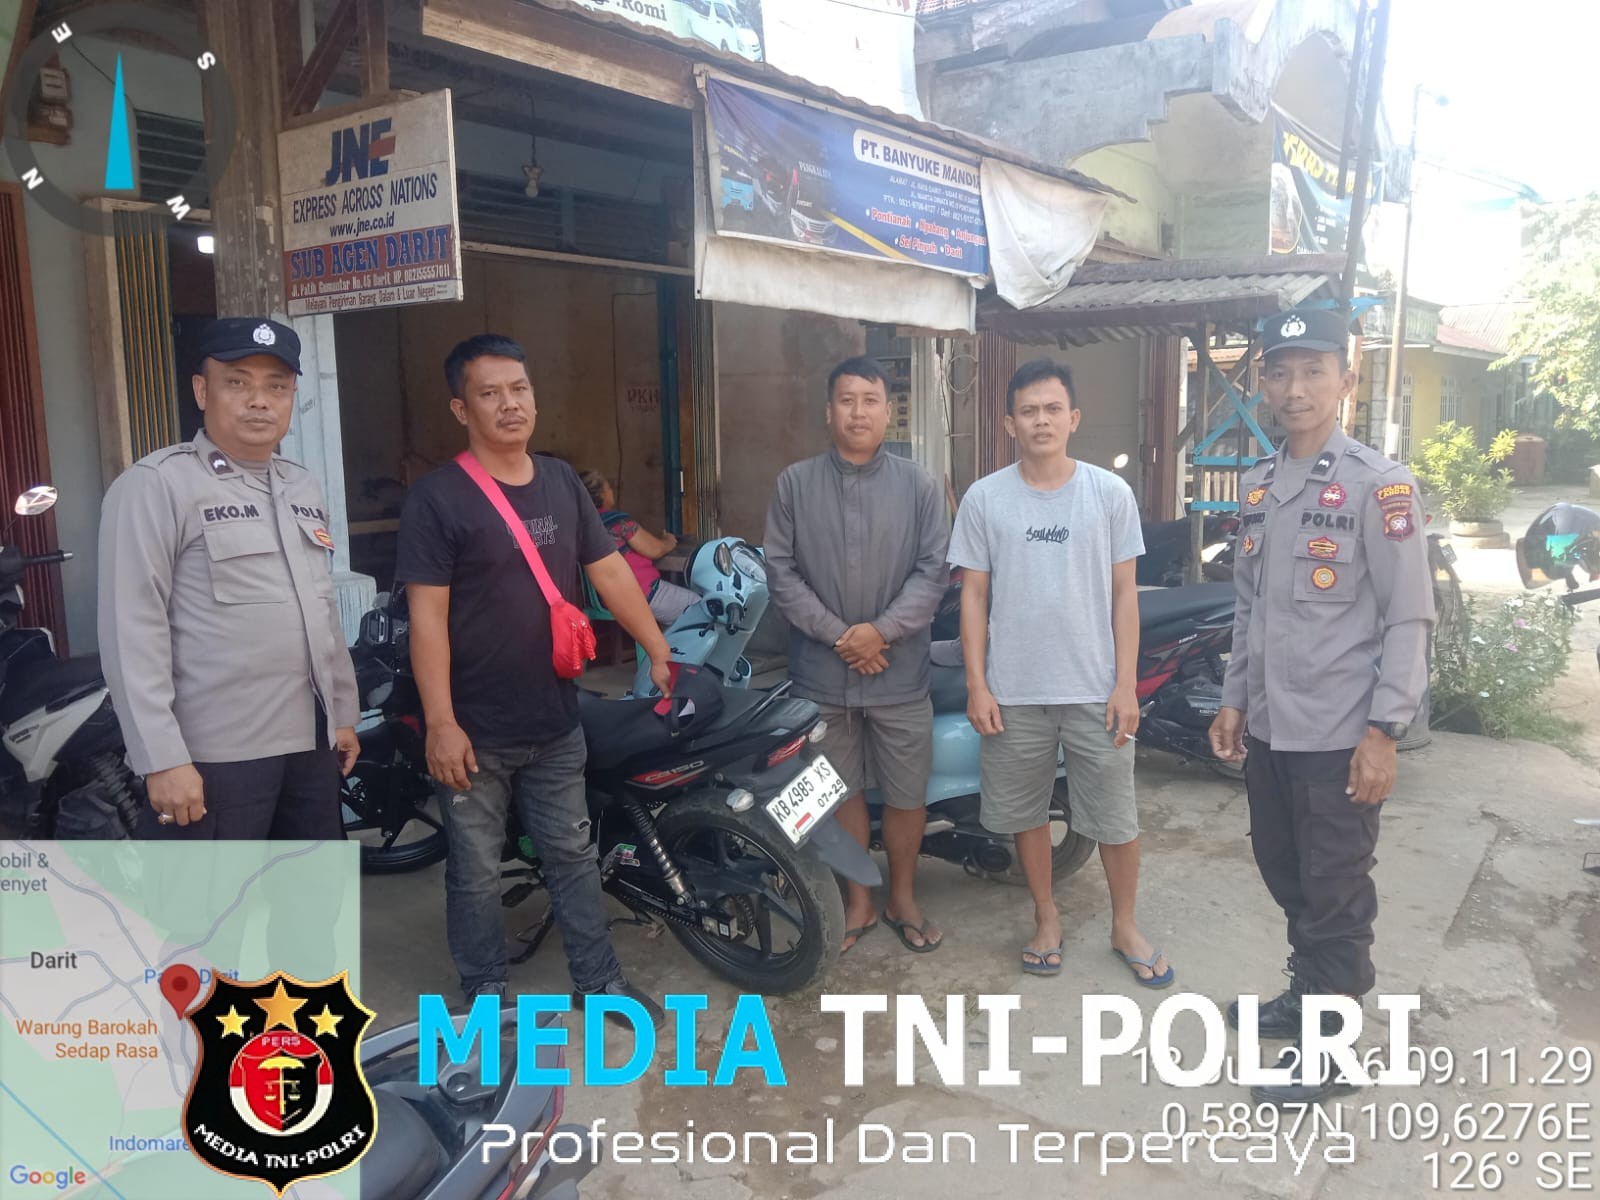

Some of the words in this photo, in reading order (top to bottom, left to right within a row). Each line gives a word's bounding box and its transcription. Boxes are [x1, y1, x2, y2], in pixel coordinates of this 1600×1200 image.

[325, 117, 396, 186] JNE
[861, 138, 880, 160] PT.
[883, 145, 940, 177] BANYUKE
[293, 194, 337, 224] EXPRESS
[342, 183, 384, 215] ACROSS
[390, 172, 438, 206] NATIONS
[330, 211, 394, 238] www.jne.co.id
[871, 207, 912, 228] Pontianak
[291, 248, 325, 280] SUB
[331, 239, 379, 275] AGEN
[385, 227, 450, 269] DARIT
[945, 244, 963, 259] Darit
[203, 503, 260, 522] EKO.M
[1301, 511, 1354, 531] POLRI
[772, 800, 791, 822] KB
[788, 776, 814, 808] 4985
[813, 761, 831, 783] XS
